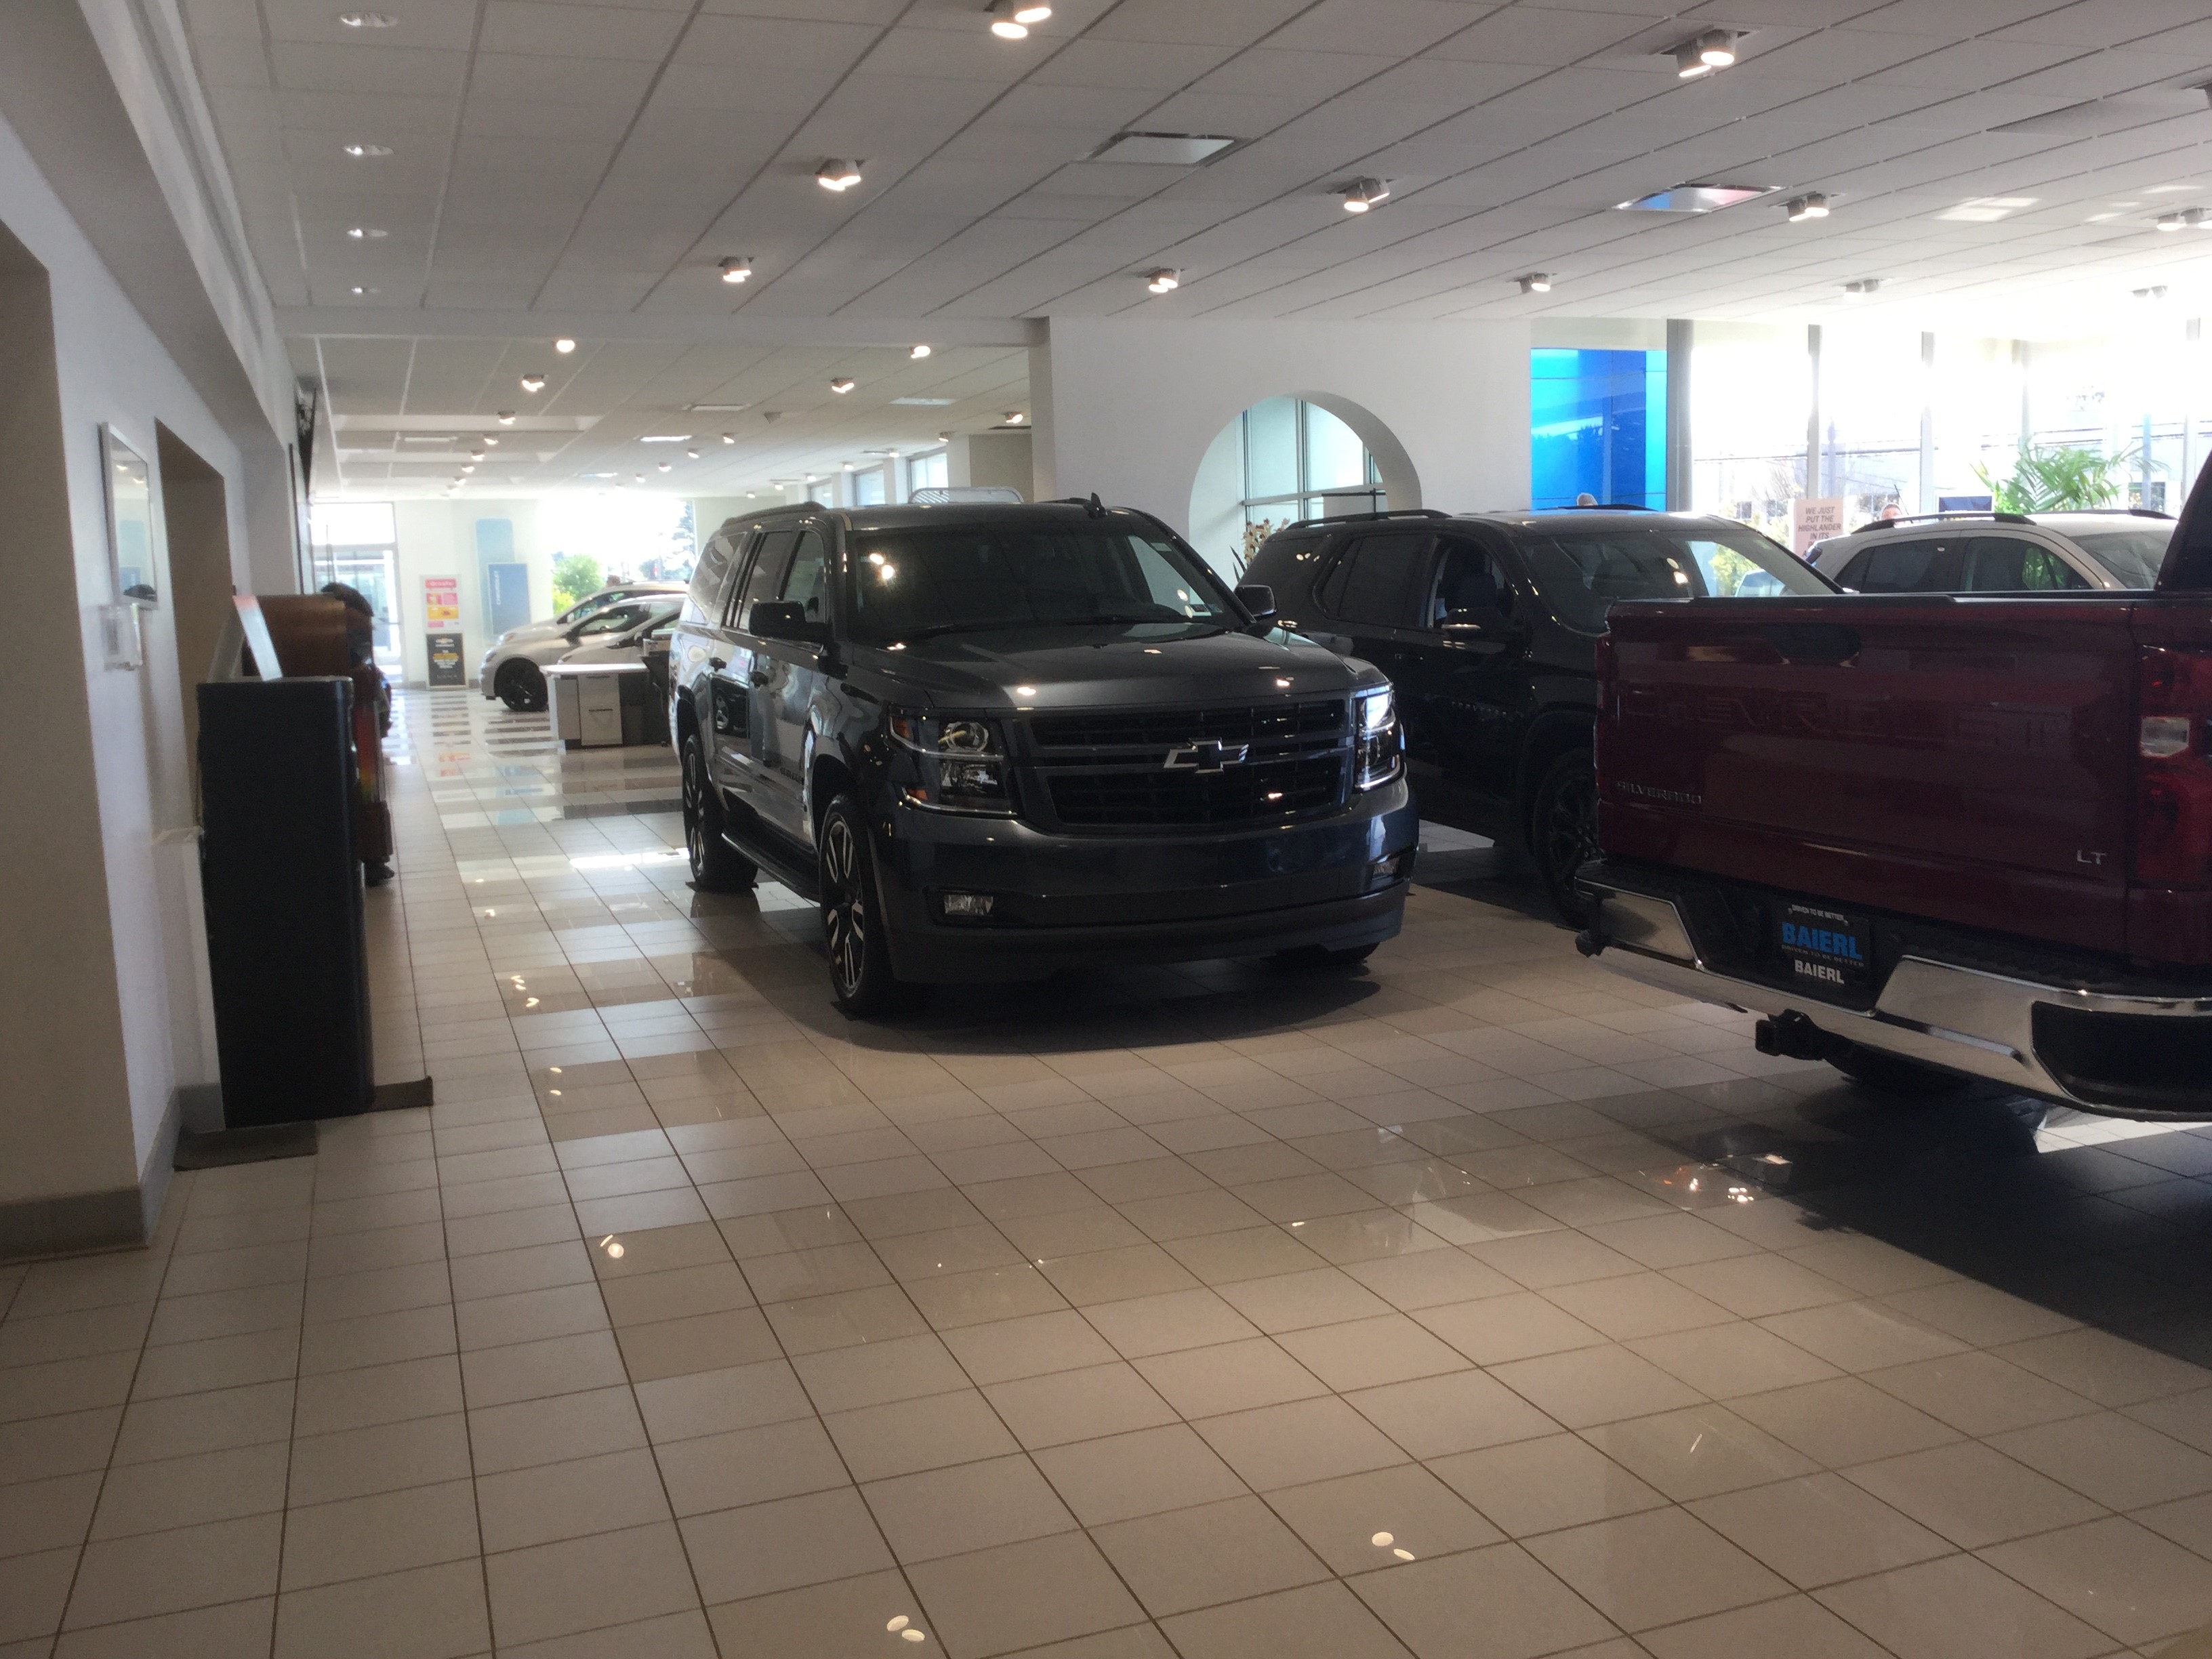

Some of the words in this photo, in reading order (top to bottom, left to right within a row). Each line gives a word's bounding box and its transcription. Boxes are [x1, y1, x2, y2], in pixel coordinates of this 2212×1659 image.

[1818, 506, 1835, 514] JUST
[1798, 523, 1841, 531] HIGHLANDER
[1616, 781, 1702, 804] SILVERADO
[2076, 849, 2106, 865] LT
[1782, 921, 1862, 960] BAIERL
[1795, 960, 1845, 984] BAIERL
